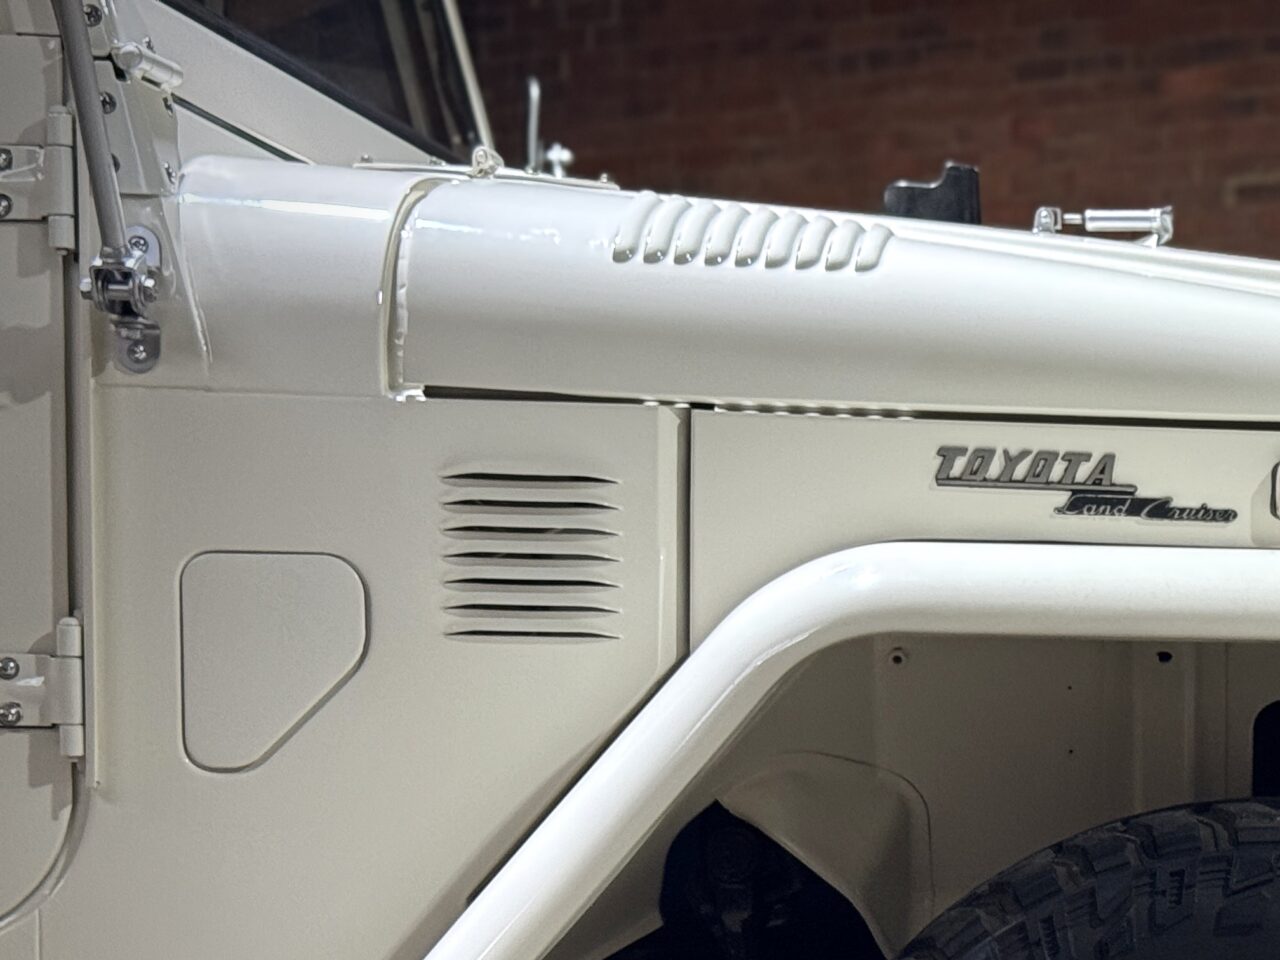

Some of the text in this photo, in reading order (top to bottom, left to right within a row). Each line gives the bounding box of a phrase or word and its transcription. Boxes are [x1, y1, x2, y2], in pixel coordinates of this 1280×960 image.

[935, 446, 1116, 486] TOYOTA
[1056, 493, 1238, 522] Land Cruiser
